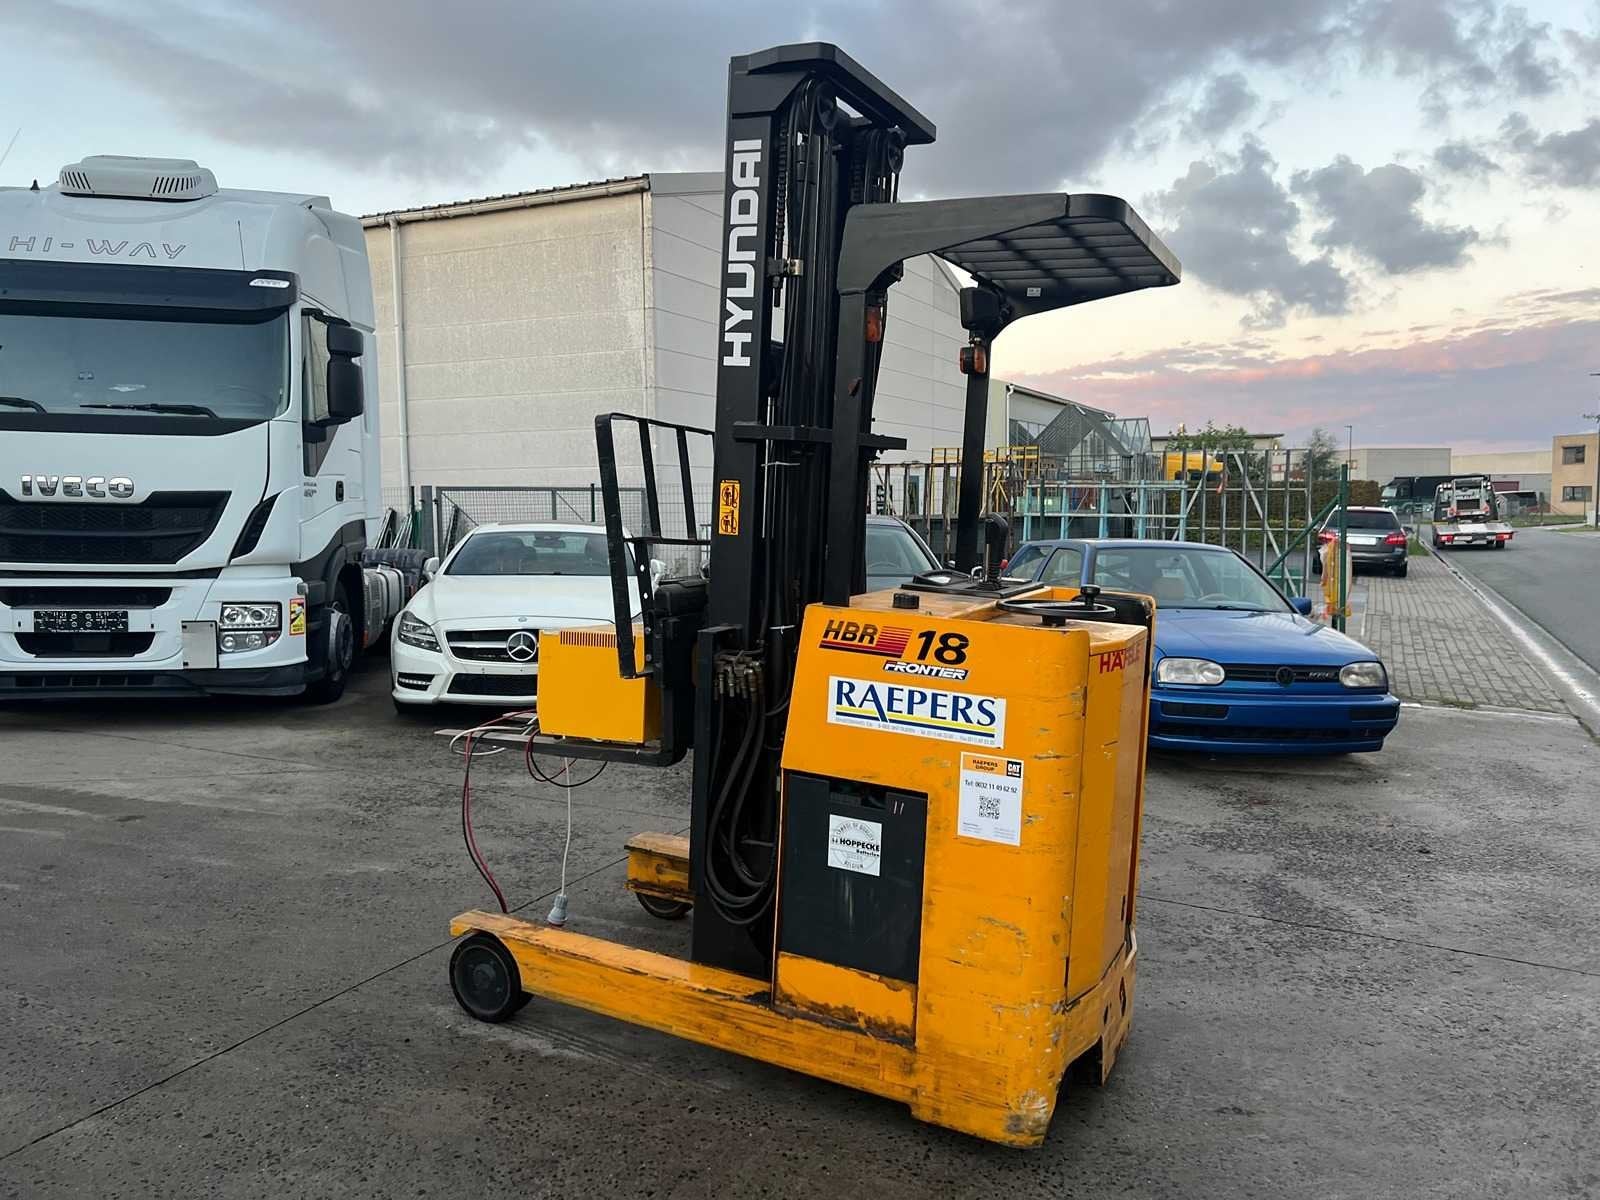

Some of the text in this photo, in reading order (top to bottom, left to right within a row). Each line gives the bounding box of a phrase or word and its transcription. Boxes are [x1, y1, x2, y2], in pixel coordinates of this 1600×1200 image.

[723, 139, 762, 367] HYUNDAI
[21, 475, 135, 499] IVECO
[822, 619, 970, 666] HBR 18
[884, 661, 967, 681] FRONTIER
[835, 680, 997, 727] RAEPERS
[972, 759, 998, 768] RAEPERS
[1007, 763, 1021, 773] CAT
[839, 837, 880, 852] HOPPECKE
